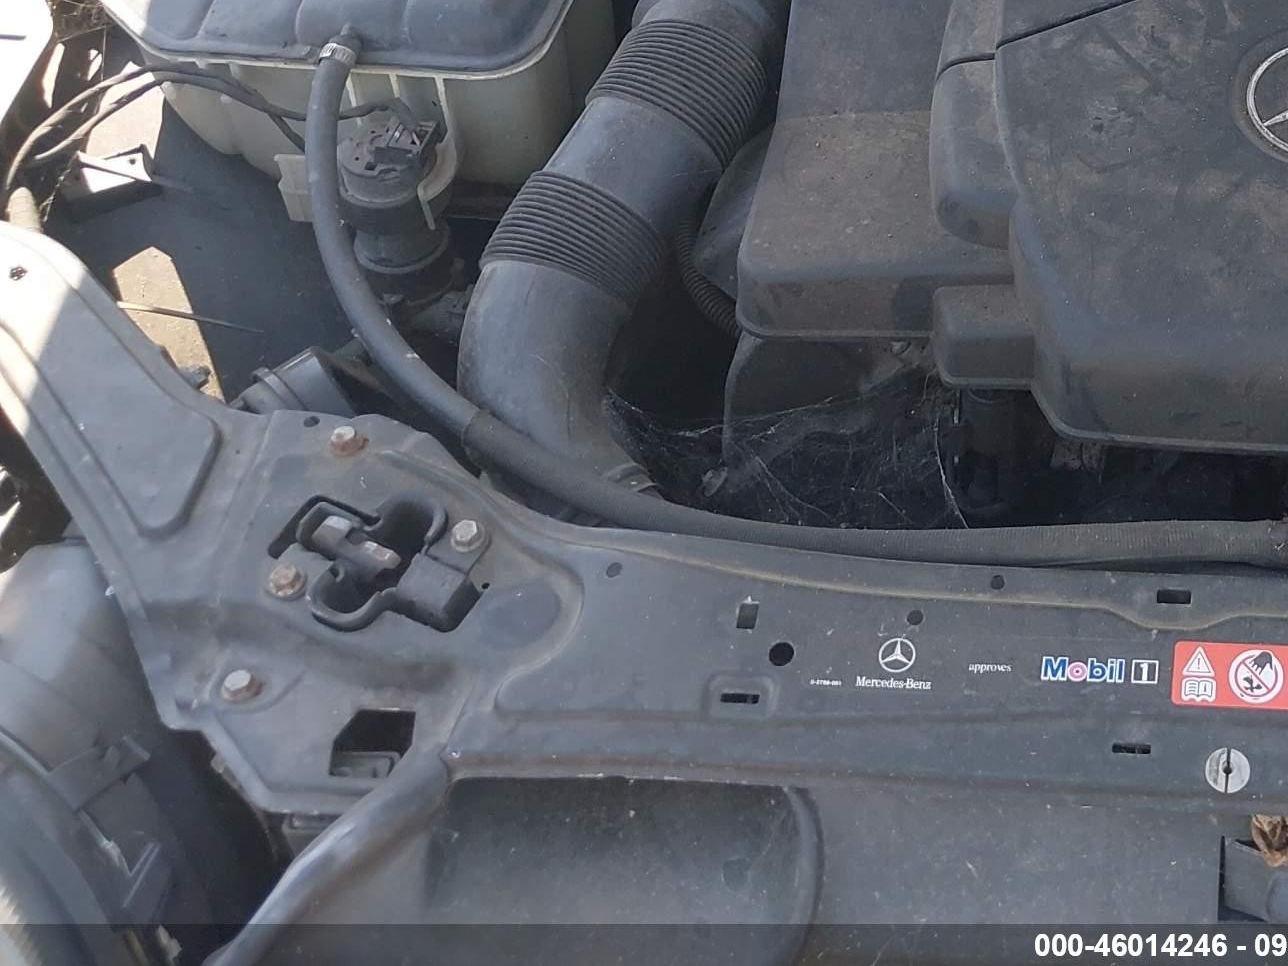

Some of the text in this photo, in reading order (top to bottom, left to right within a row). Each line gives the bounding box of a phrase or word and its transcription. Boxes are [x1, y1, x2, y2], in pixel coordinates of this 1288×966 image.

[968, 662, 1012, 675] approves
[1040, 655, 1126, 683] Mobil
[856, 676, 932, 690] Mercedes-Benz
